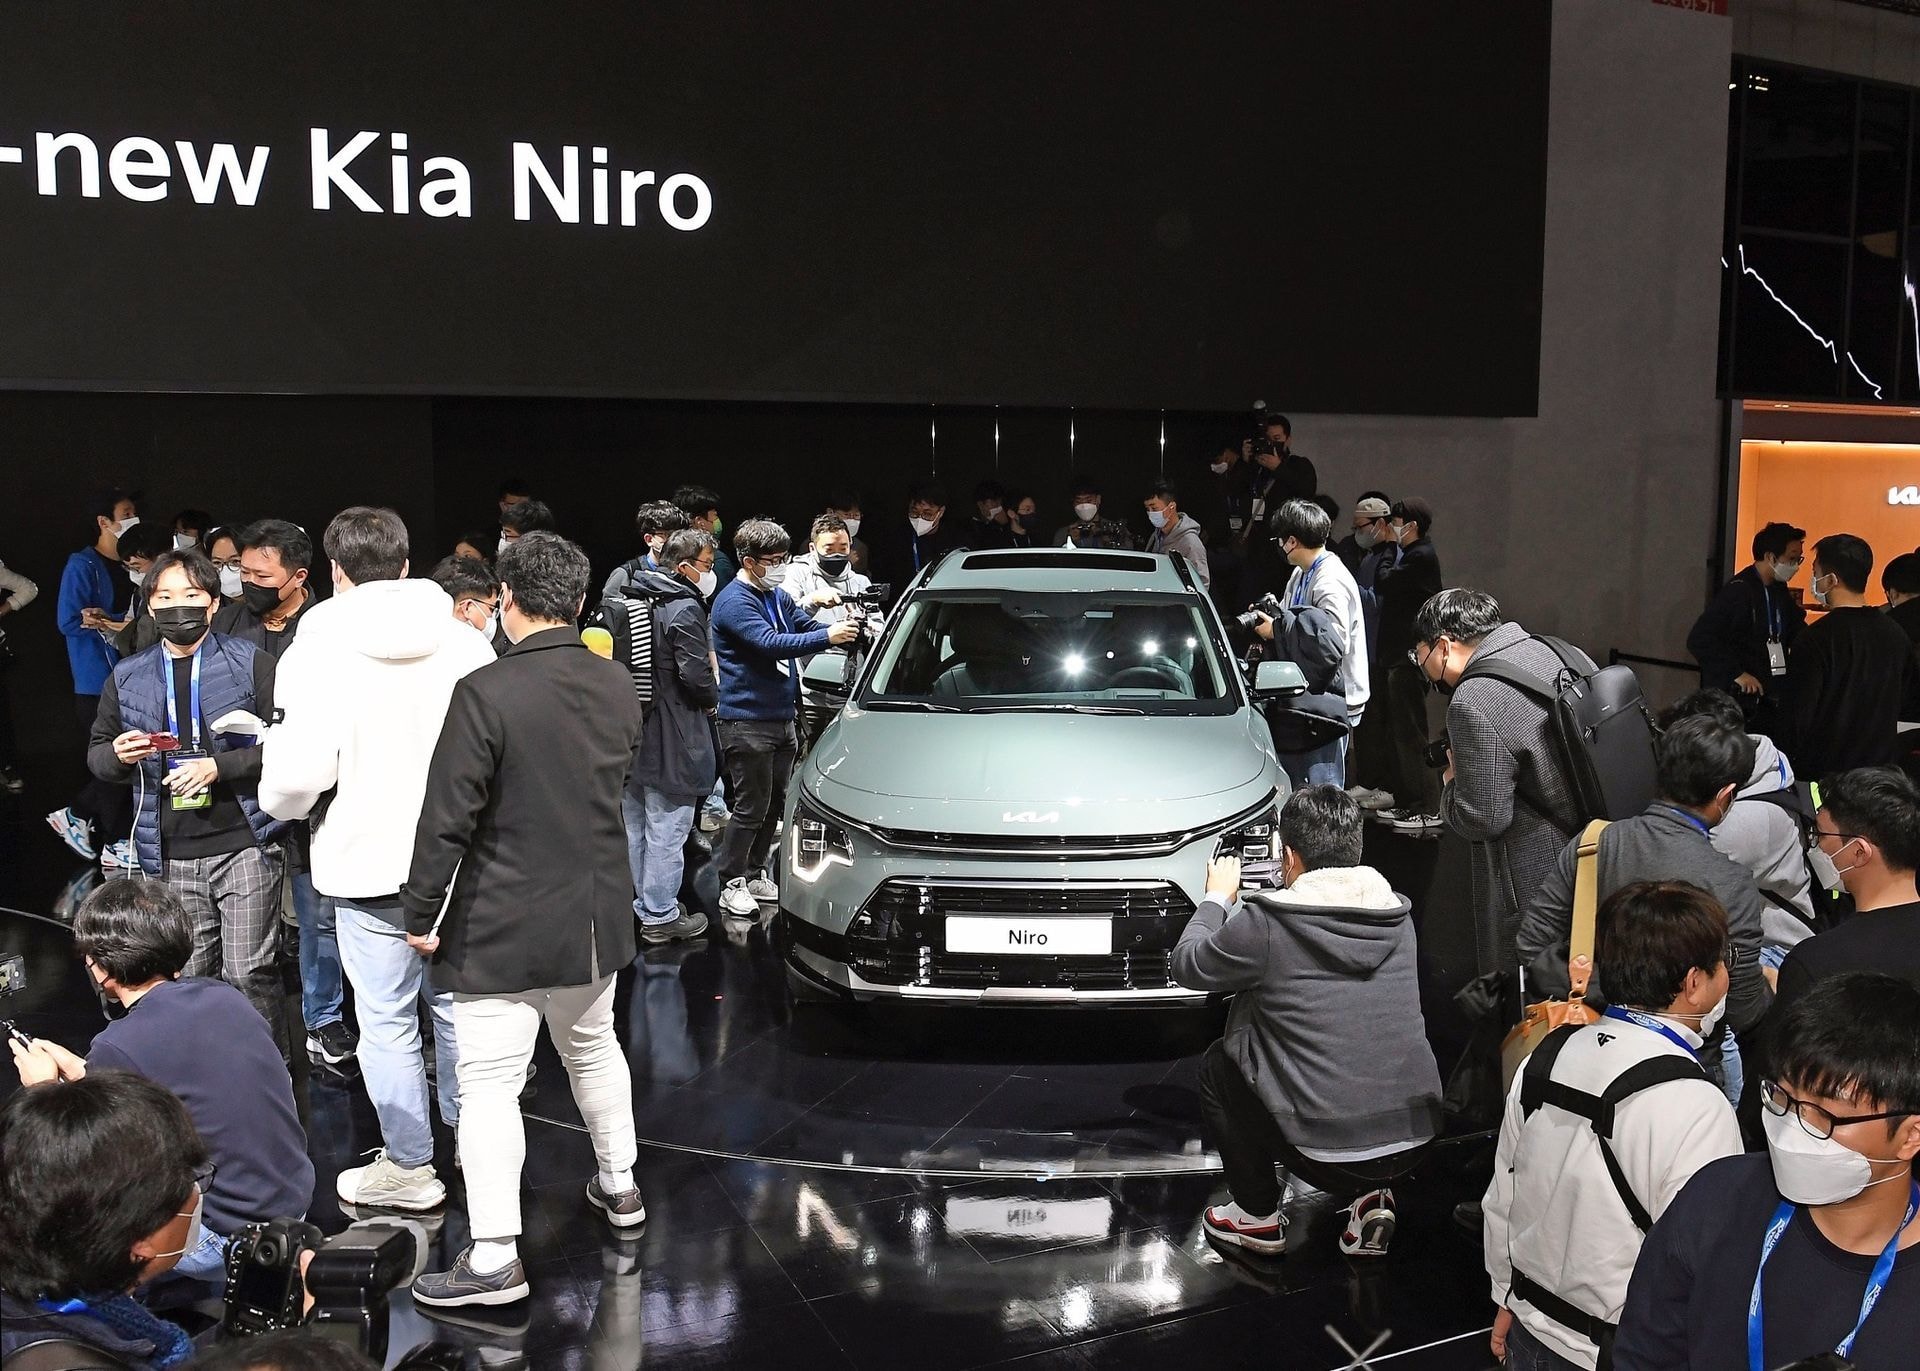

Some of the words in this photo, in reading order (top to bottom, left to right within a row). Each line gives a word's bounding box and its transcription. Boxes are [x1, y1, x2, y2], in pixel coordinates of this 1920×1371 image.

[311, 128, 471, 217] Kia
[513, 142, 712, 230] Niro
[1009, 930, 1047, 945] Niro
